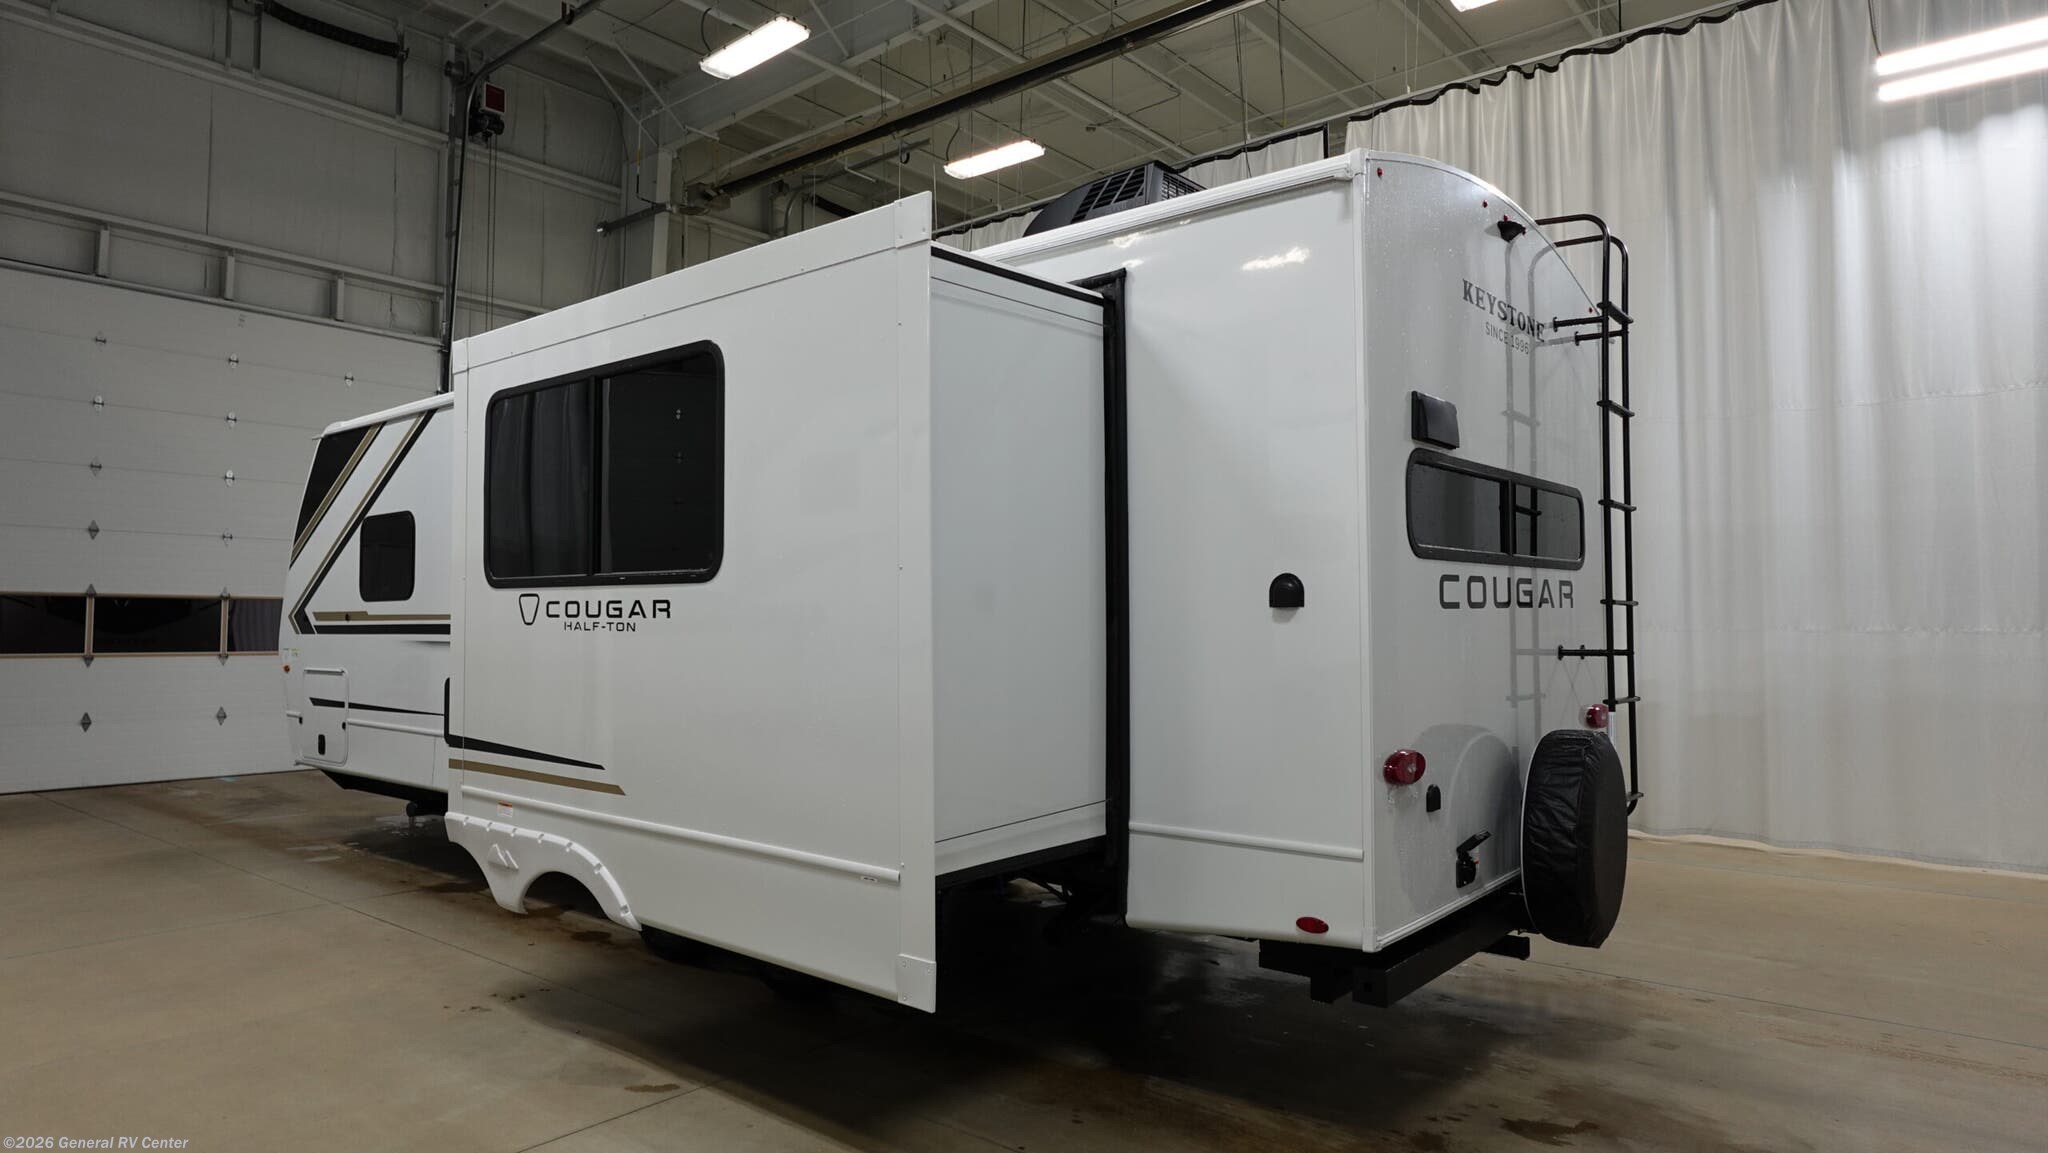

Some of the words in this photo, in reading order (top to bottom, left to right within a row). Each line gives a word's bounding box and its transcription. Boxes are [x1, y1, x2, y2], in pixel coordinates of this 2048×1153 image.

[1462, 278, 1545, 343] KEYSTONE
[1485, 321, 1509, 345] SINCE
[1510, 336, 1530, 355] 1996
[1439, 574, 1574, 609] COUGAR
[546, 599, 671, 619] COUGAR
[564, 621, 637, 632] HALF-TON
